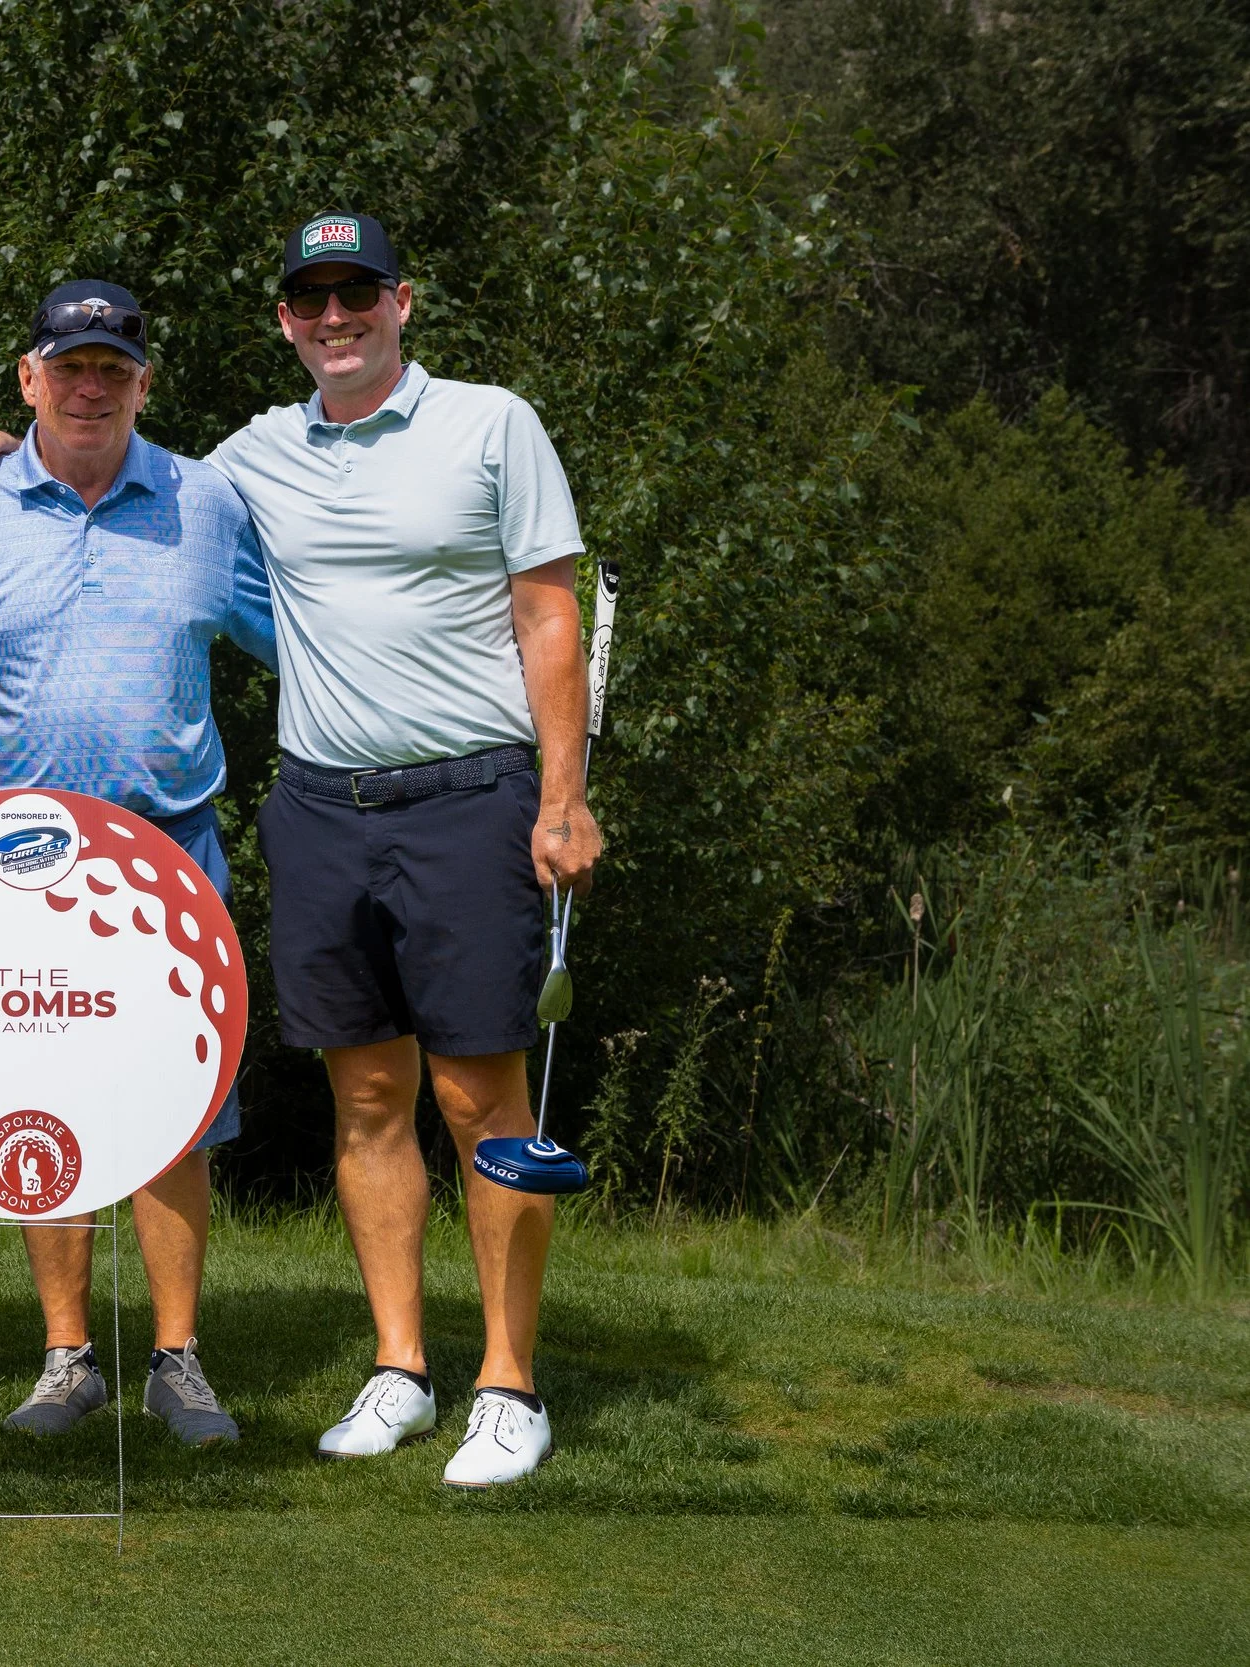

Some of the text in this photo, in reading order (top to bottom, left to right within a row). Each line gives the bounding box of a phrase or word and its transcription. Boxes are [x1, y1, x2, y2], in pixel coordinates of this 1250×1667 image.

[321, 225, 353, 234] BIG
[321, 233, 354, 242] BASS
[3, 840, 65, 862] PURFECT
[26, 1178, 40, 1192] 37
[36, 1155, 77, 1208] CLASSIC
